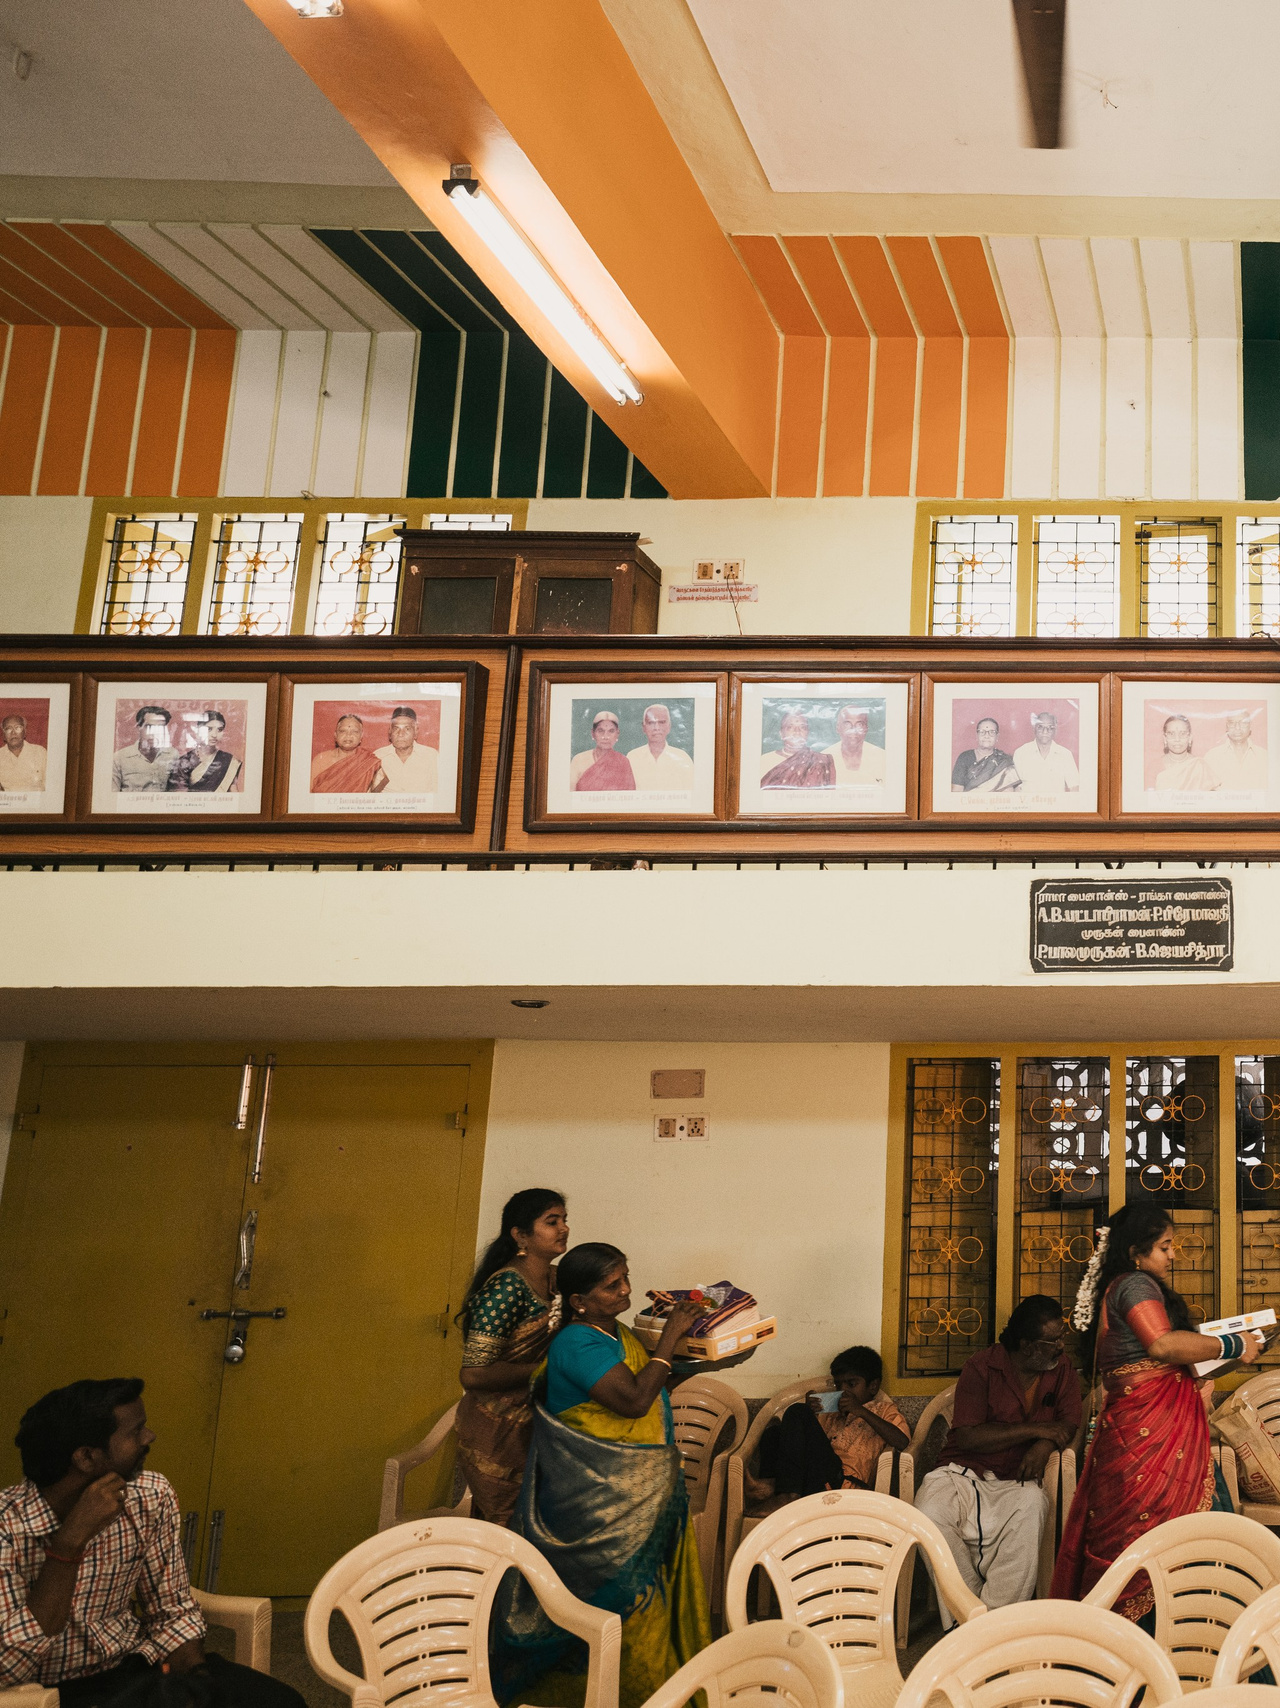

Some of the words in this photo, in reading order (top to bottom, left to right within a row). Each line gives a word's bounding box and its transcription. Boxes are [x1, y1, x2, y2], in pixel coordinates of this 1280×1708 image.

[1038, 891, 1067, 904] ராமா
[1067, 889, 1129, 902] பைனான்ஸ்
[1137, 889, 1172, 903] ரங்கா
[1173, 888, 1229, 901] பைனான்ஸ்
[1081, 926, 1125, 940] முருகன்
[1127, 925, 1186, 938] பைனான்ஸ்
